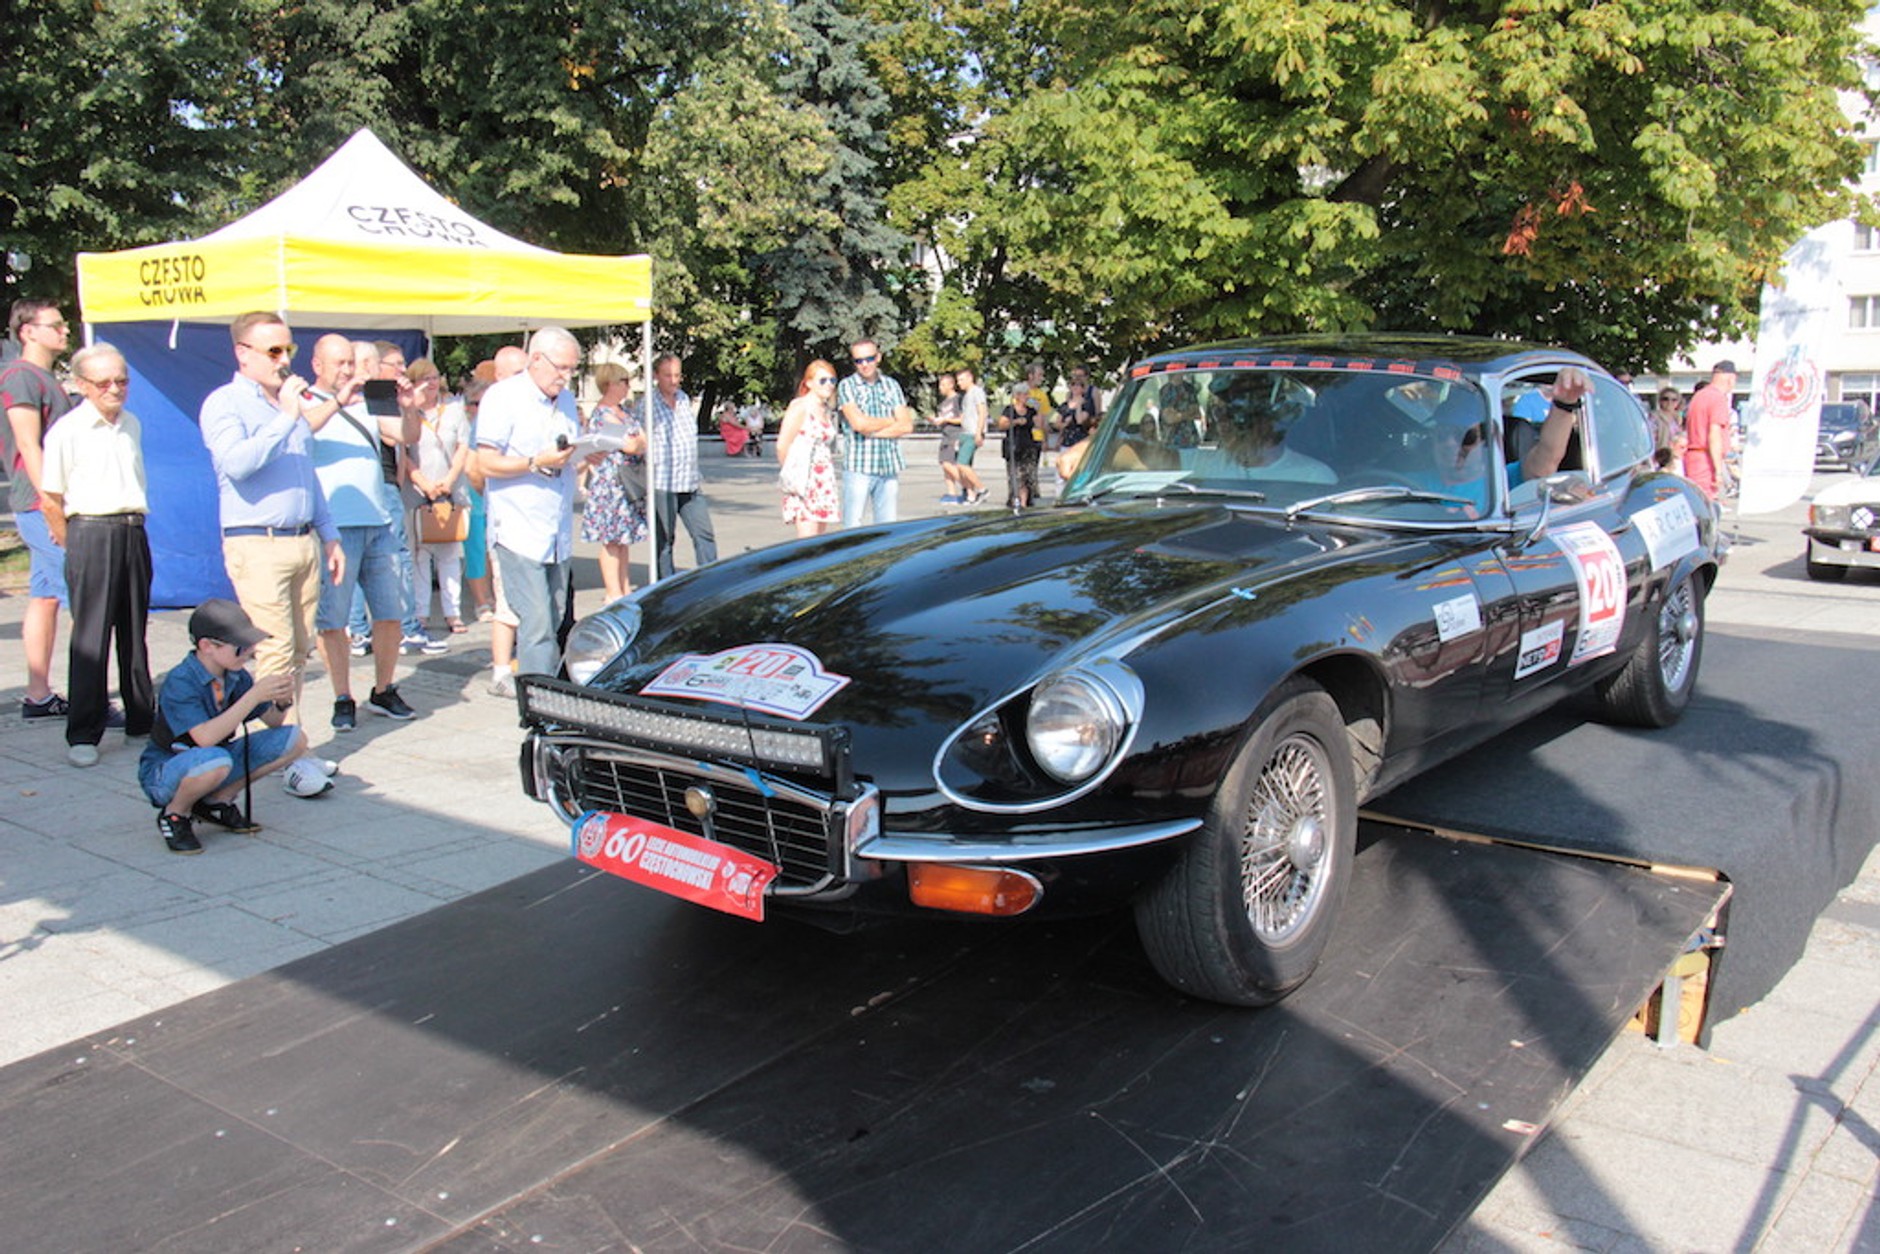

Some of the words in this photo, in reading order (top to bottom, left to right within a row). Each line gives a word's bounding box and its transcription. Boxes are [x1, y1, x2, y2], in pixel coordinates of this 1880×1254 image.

[1585, 557, 1616, 613] 20
[730, 649, 792, 678] 20
[604, 828, 647, 864] 60
